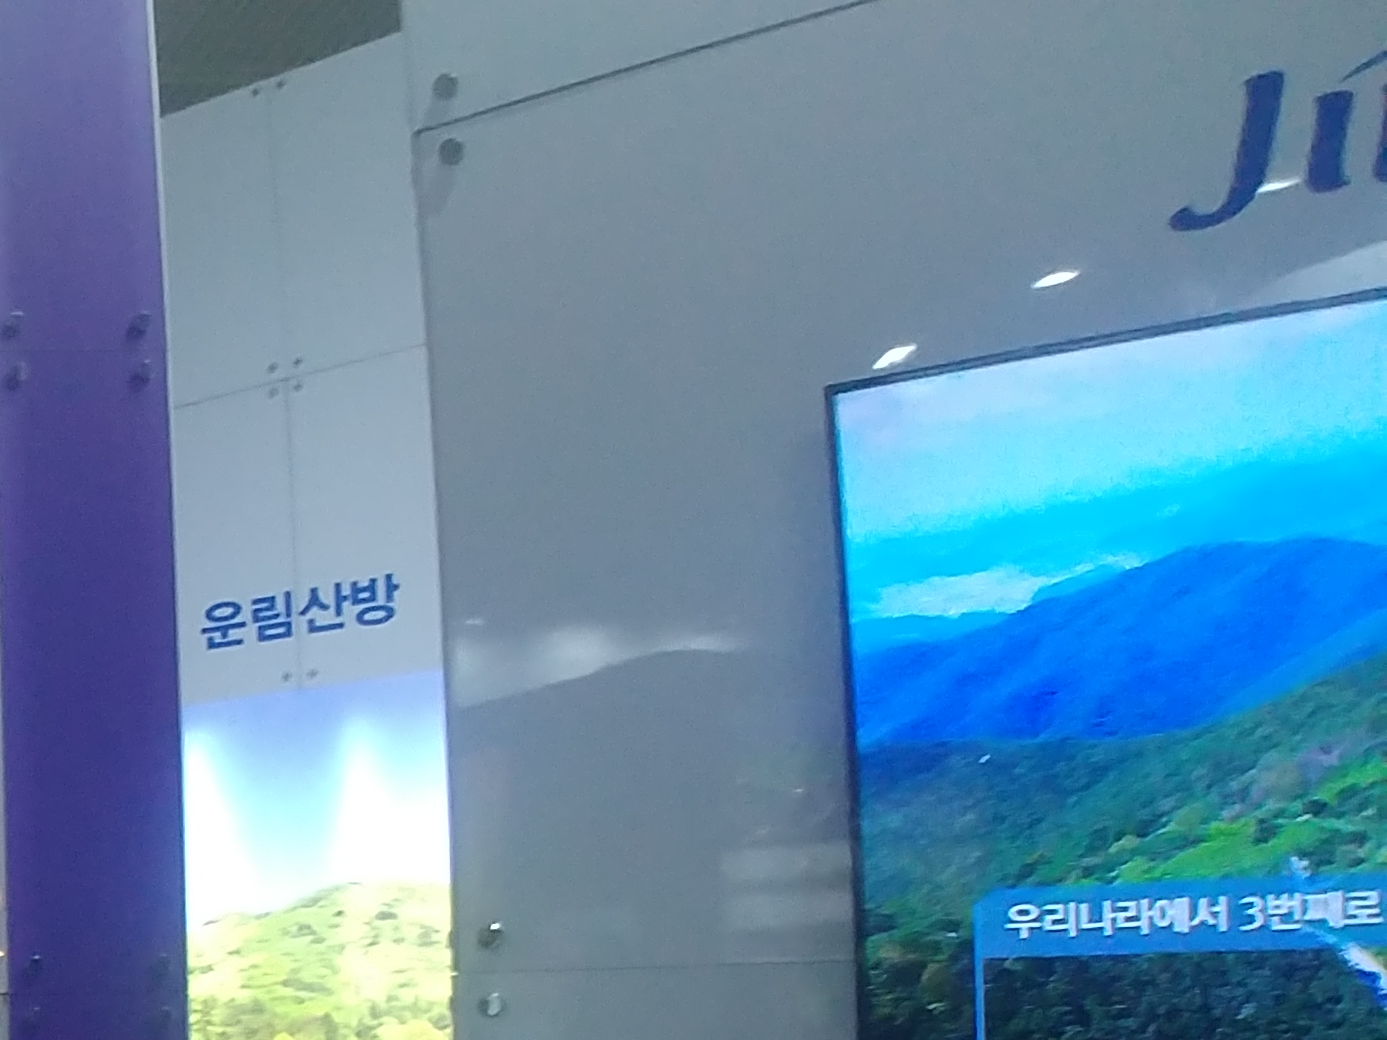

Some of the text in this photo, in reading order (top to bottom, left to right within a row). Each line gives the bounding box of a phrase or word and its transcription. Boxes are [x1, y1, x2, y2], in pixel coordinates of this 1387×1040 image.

[1168, 50, 1387, 232] Ji
[200, 572, 400, 651] 운림산방
[1003, 896, 1227, 940] 우리나라에서
